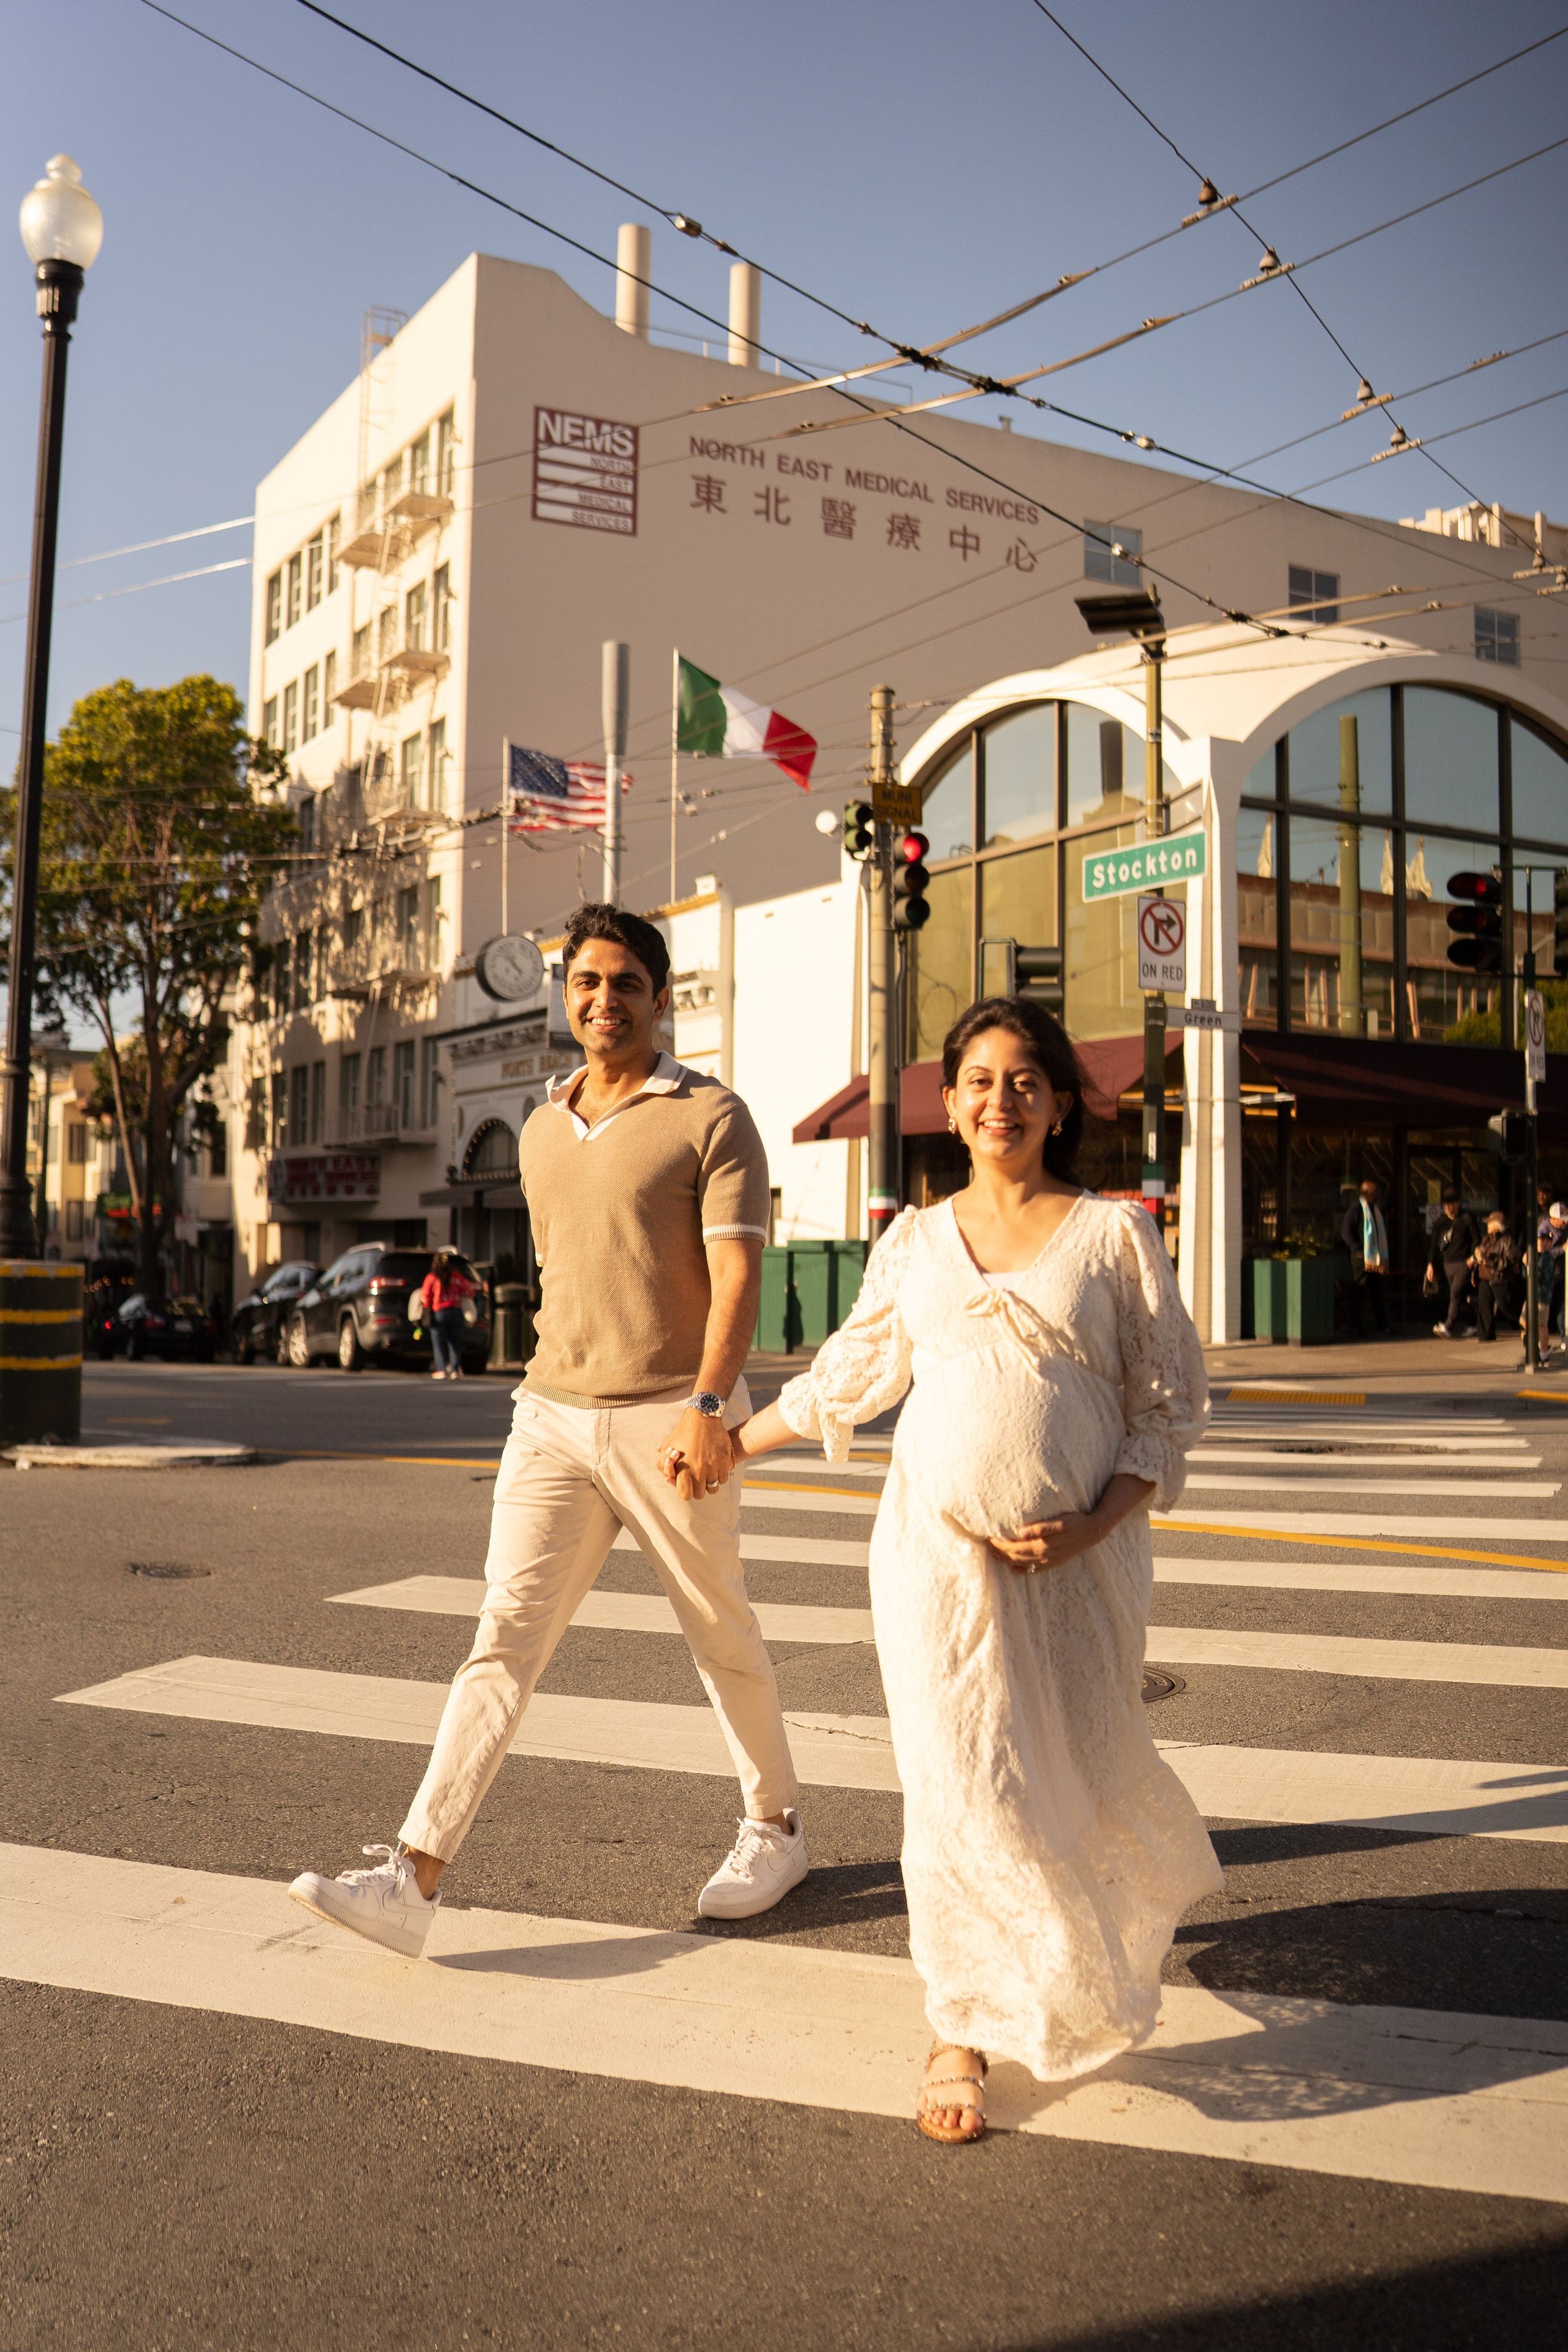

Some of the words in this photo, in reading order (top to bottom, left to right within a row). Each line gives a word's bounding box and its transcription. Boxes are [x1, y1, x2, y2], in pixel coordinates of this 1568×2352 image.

[538, 410, 635, 458] NEMS
[590, 456, 632, 474] NORTH
[600, 474, 630, 492] EAST
[689, 435, 764, 469] NORTH
[777, 453, 832, 482] EAST
[845, 467, 935, 504] MEDICAL
[945, 488, 1039, 526] SERVICES
[578, 492, 629, 511] MEDICAL
[571, 509, 630, 532] SERVICES
[690, 474, 1038, 573] 東北醫療中心
[882, 790, 913, 803] MUNI
[876, 805, 919, 821] SIGNAL
[1093, 847, 1197, 888] Stockton
[1142, 962, 1156, 978] ON
[1162, 963, 1183, 981] RED
[1185, 1012, 1221, 1027] Green
